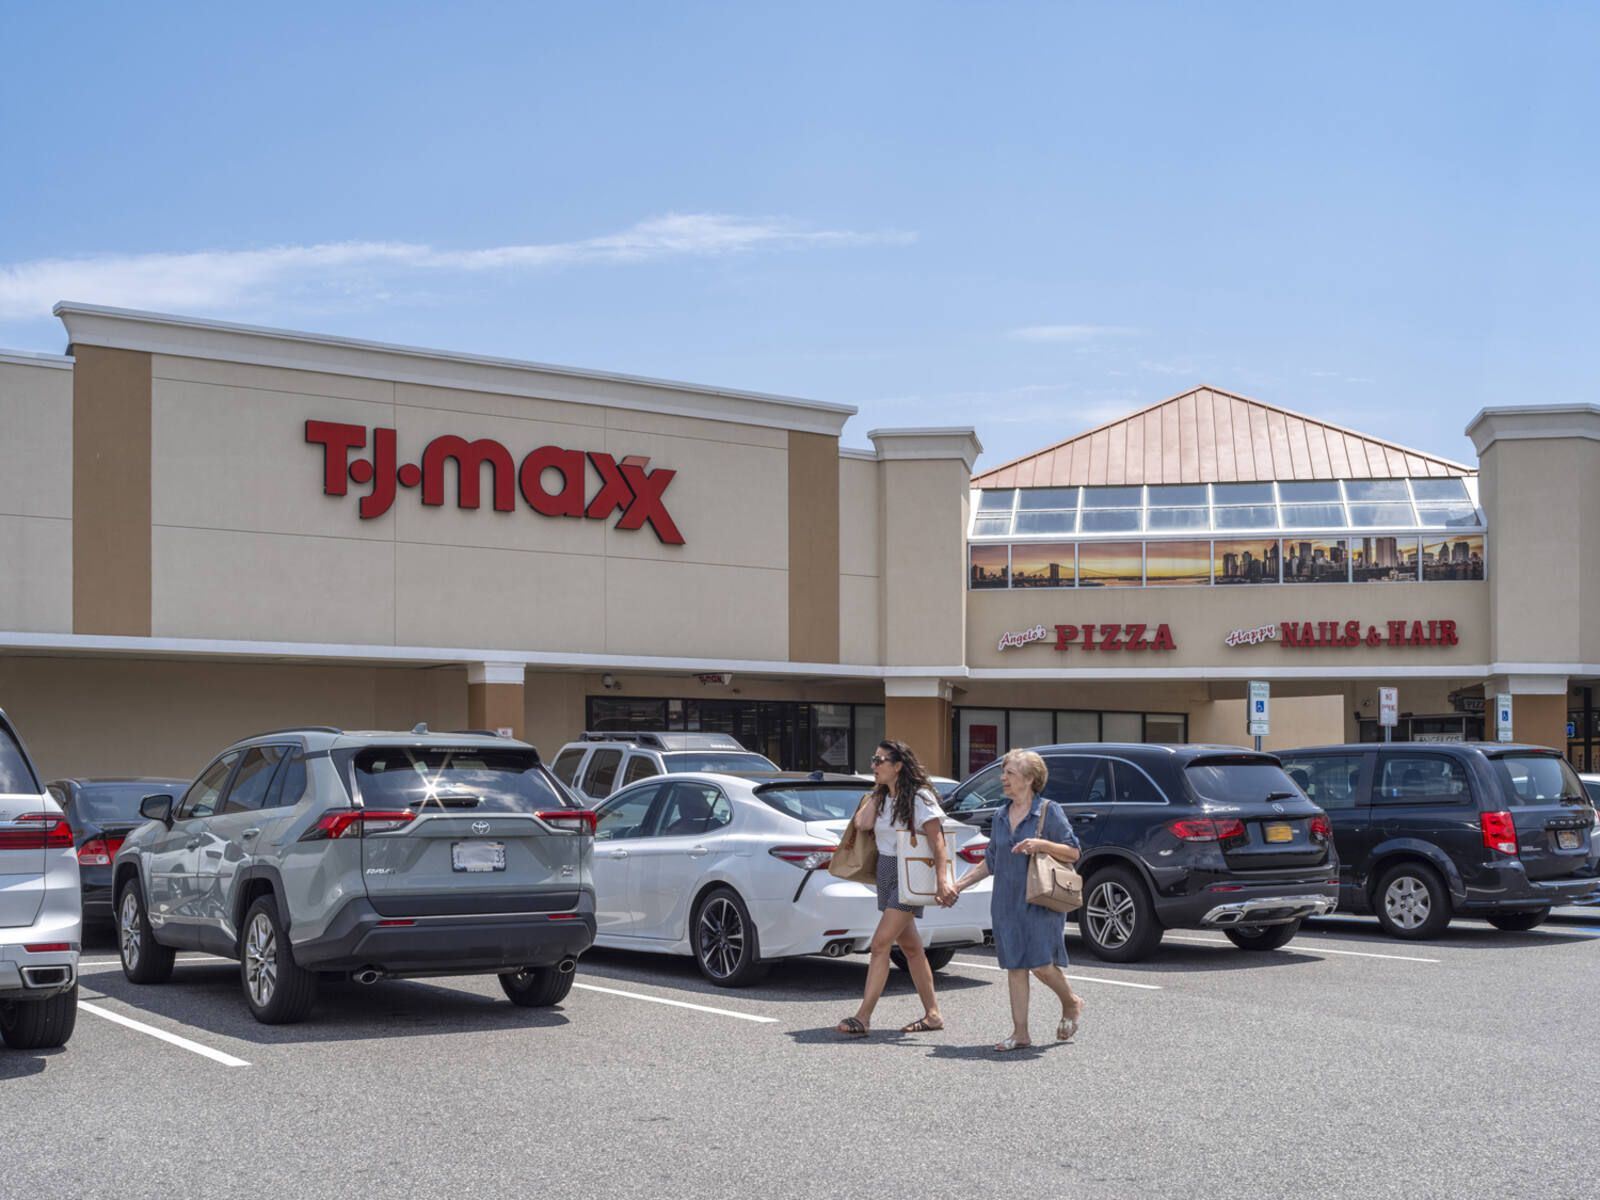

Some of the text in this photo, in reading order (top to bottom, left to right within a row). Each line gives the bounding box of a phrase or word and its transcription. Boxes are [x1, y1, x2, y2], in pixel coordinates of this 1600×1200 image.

[998, 623, 1177, 651] Angelo's PIZZA
[1225, 620, 1459, 648] Happy NAILS & HAIR
